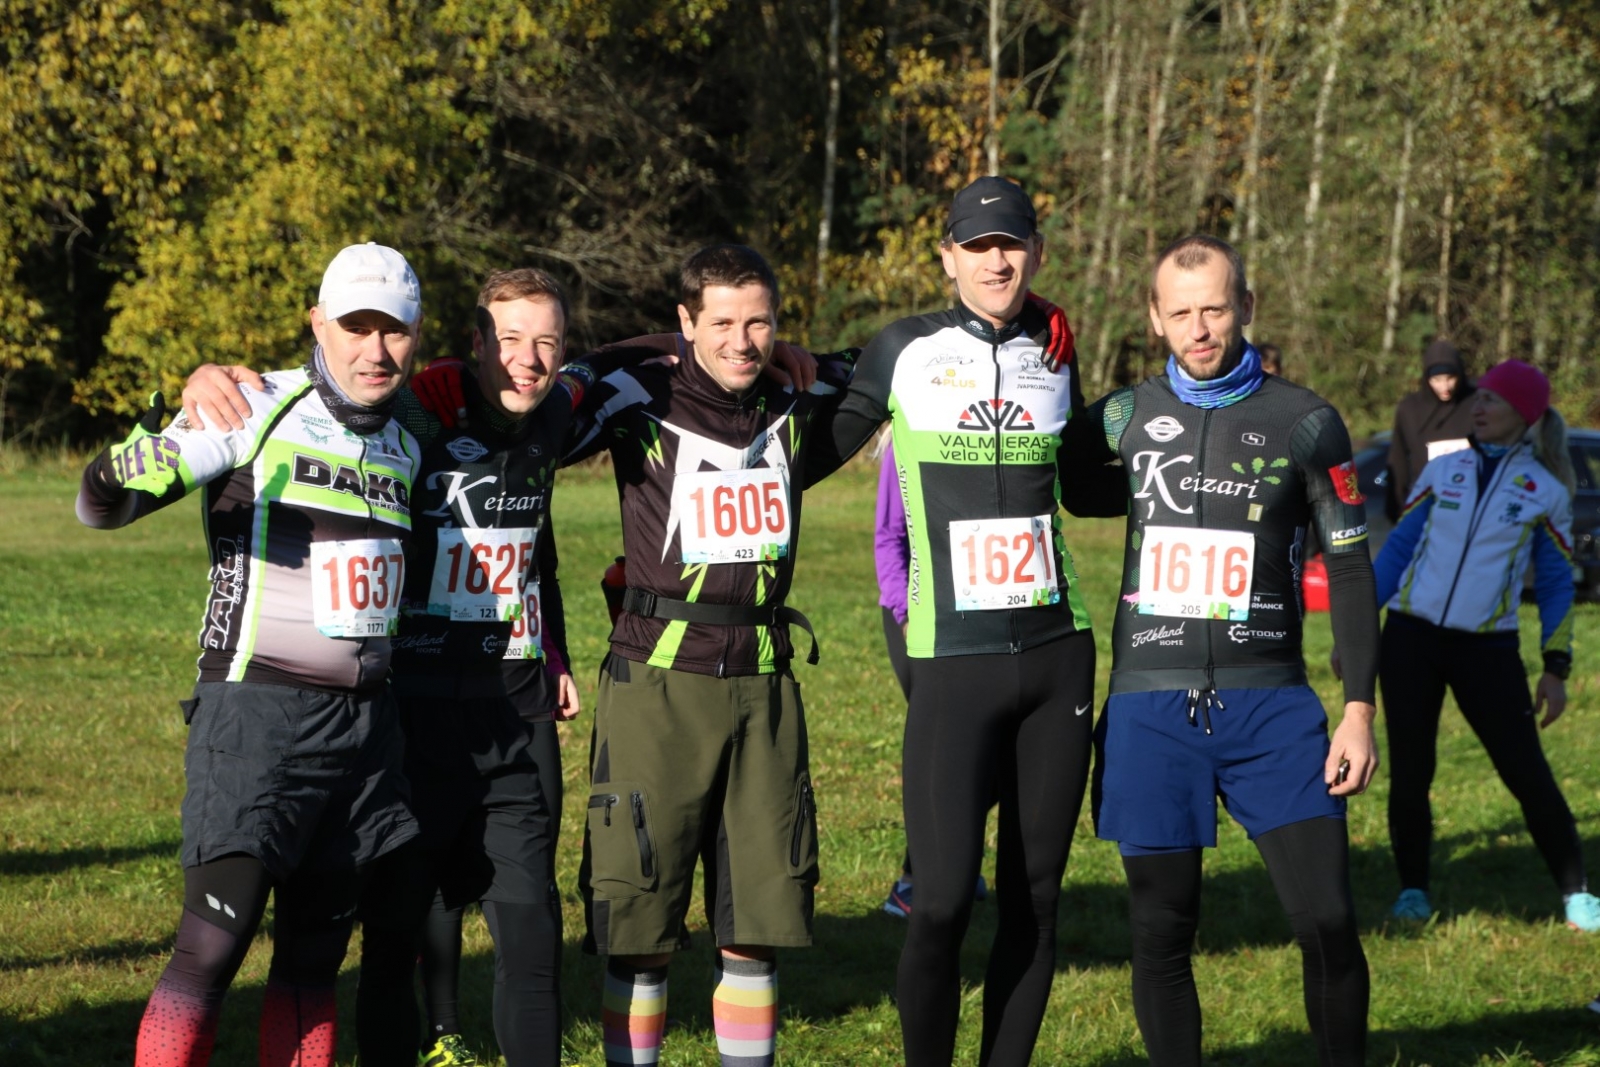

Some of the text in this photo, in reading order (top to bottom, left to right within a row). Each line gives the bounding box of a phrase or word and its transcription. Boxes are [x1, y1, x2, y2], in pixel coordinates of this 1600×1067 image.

[931, 376, 976, 388] 4PLUS
[939, 434, 1050, 449] VALMIERAS
[689, 481, 785, 539] 1605
[734, 549, 754, 560] 423
[961, 529, 1051, 585] 1621
[447, 542, 533, 595] 1625
[1150, 541, 1249, 598] 1616
[322, 554, 405, 611] 1637
[1007, 595, 1027, 605] 204
[480, 608, 497, 618] 121
[1180, 604, 1201, 615] 205
[366, 622, 385, 634] 1171
[1132, 621, 1186, 647] Folkland
